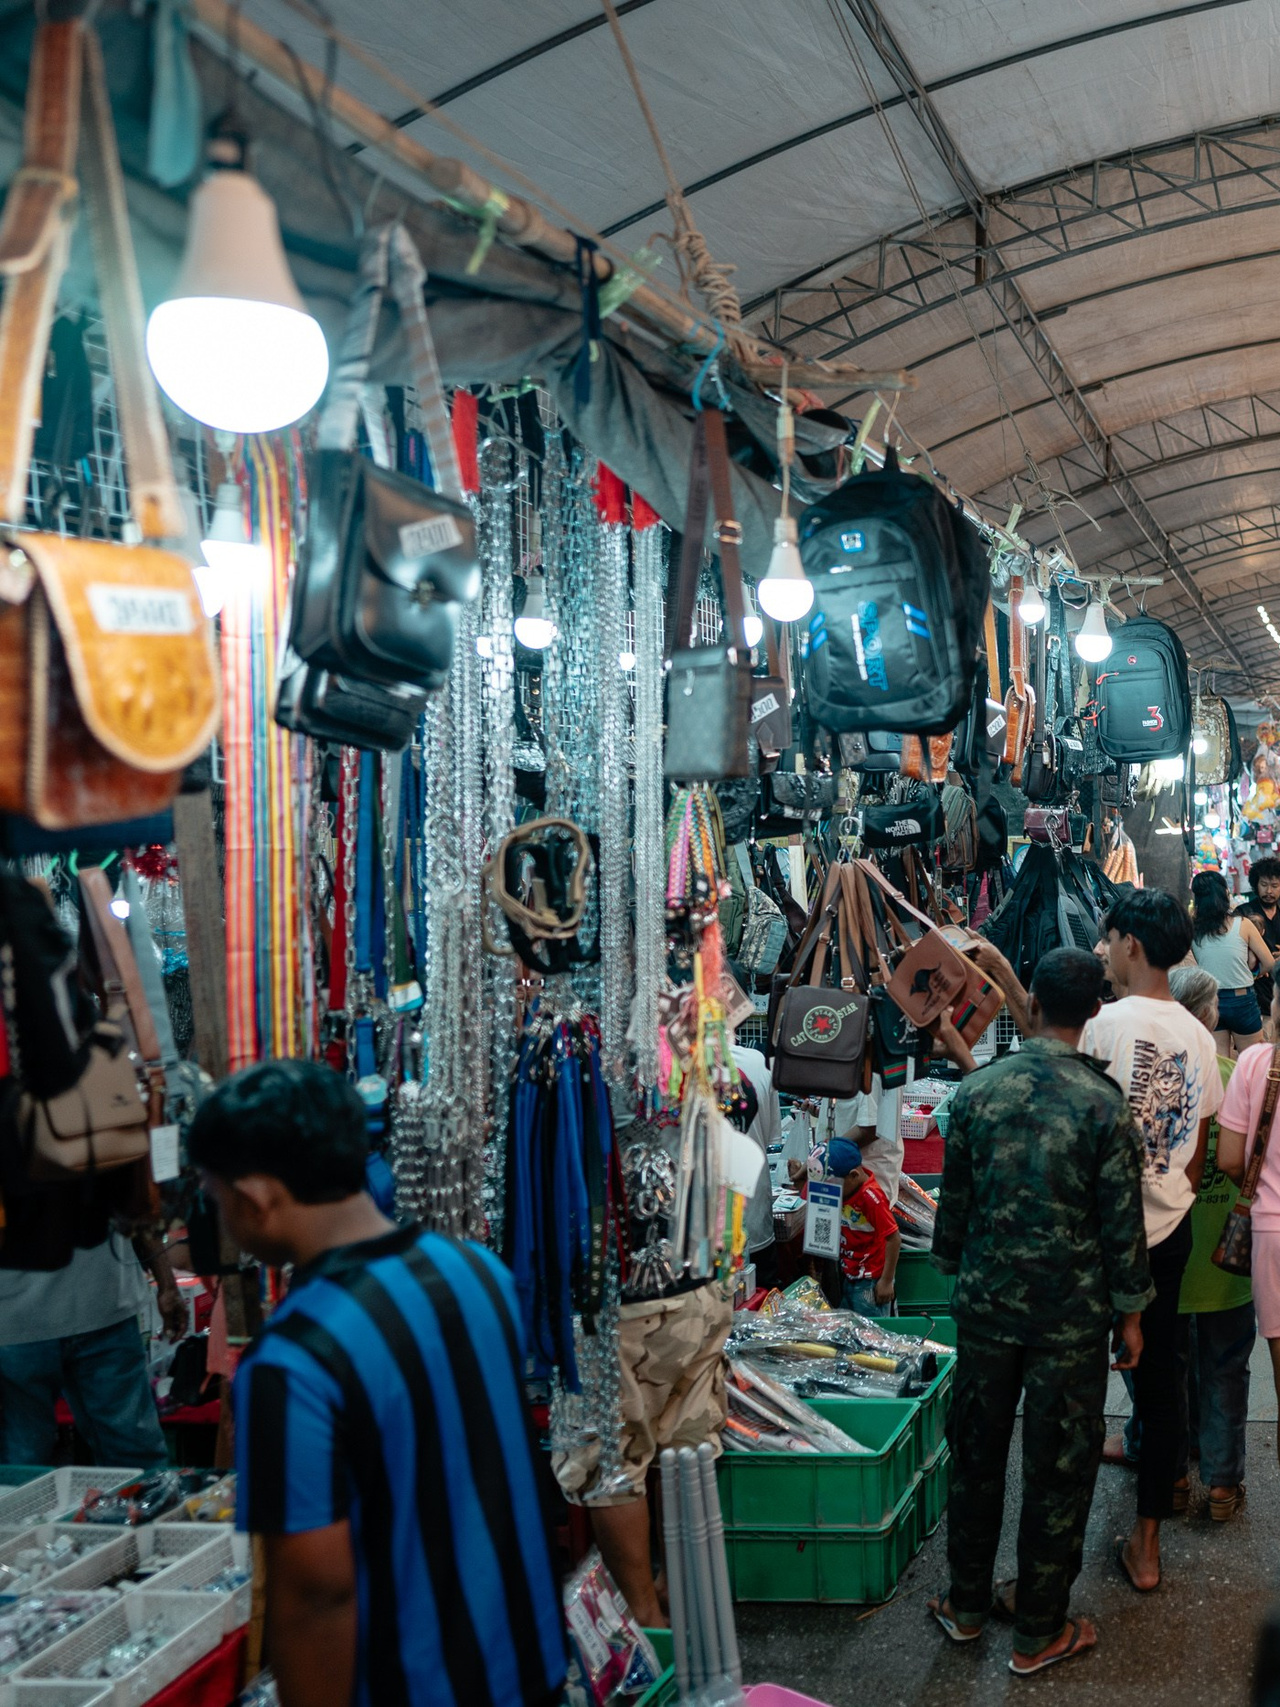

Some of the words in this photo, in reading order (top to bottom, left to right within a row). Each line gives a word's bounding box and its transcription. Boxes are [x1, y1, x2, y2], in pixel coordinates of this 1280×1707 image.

[857, 600, 889, 691] SPORT
[885, 824, 909, 834] NORTH
[894, 820, 908, 828] THE
[836, 1002, 859, 1019] STAR
[790, 1031, 808, 1047] CAT
